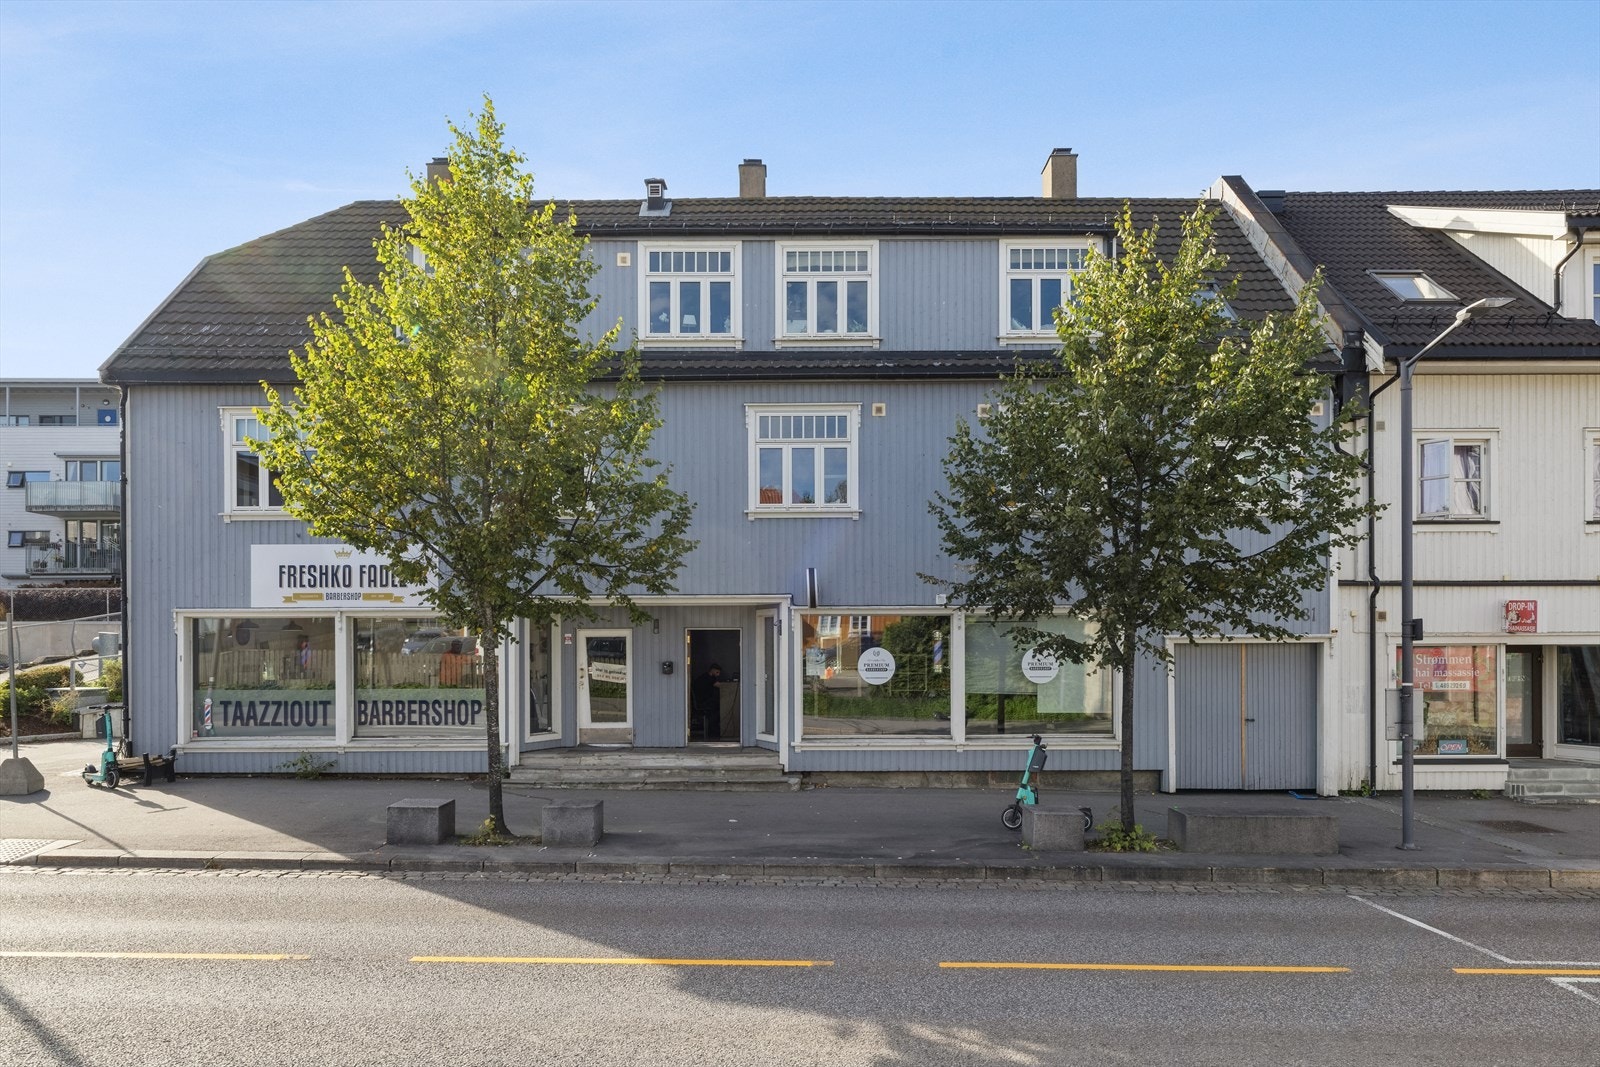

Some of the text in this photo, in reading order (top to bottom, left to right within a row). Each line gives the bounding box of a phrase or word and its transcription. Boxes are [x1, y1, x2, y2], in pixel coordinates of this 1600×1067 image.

[278, 564, 353, 588] FRESHKO
[325, 592, 362, 601] BARBERSHOP
[1508, 602, 1535, 611] DROP-IN
[1415, 654, 1472, 665] Strømmen
[1413, 668, 1430, 677] hai
[219, 699, 483, 727] TAAZZIOUT BARBERSHOP
